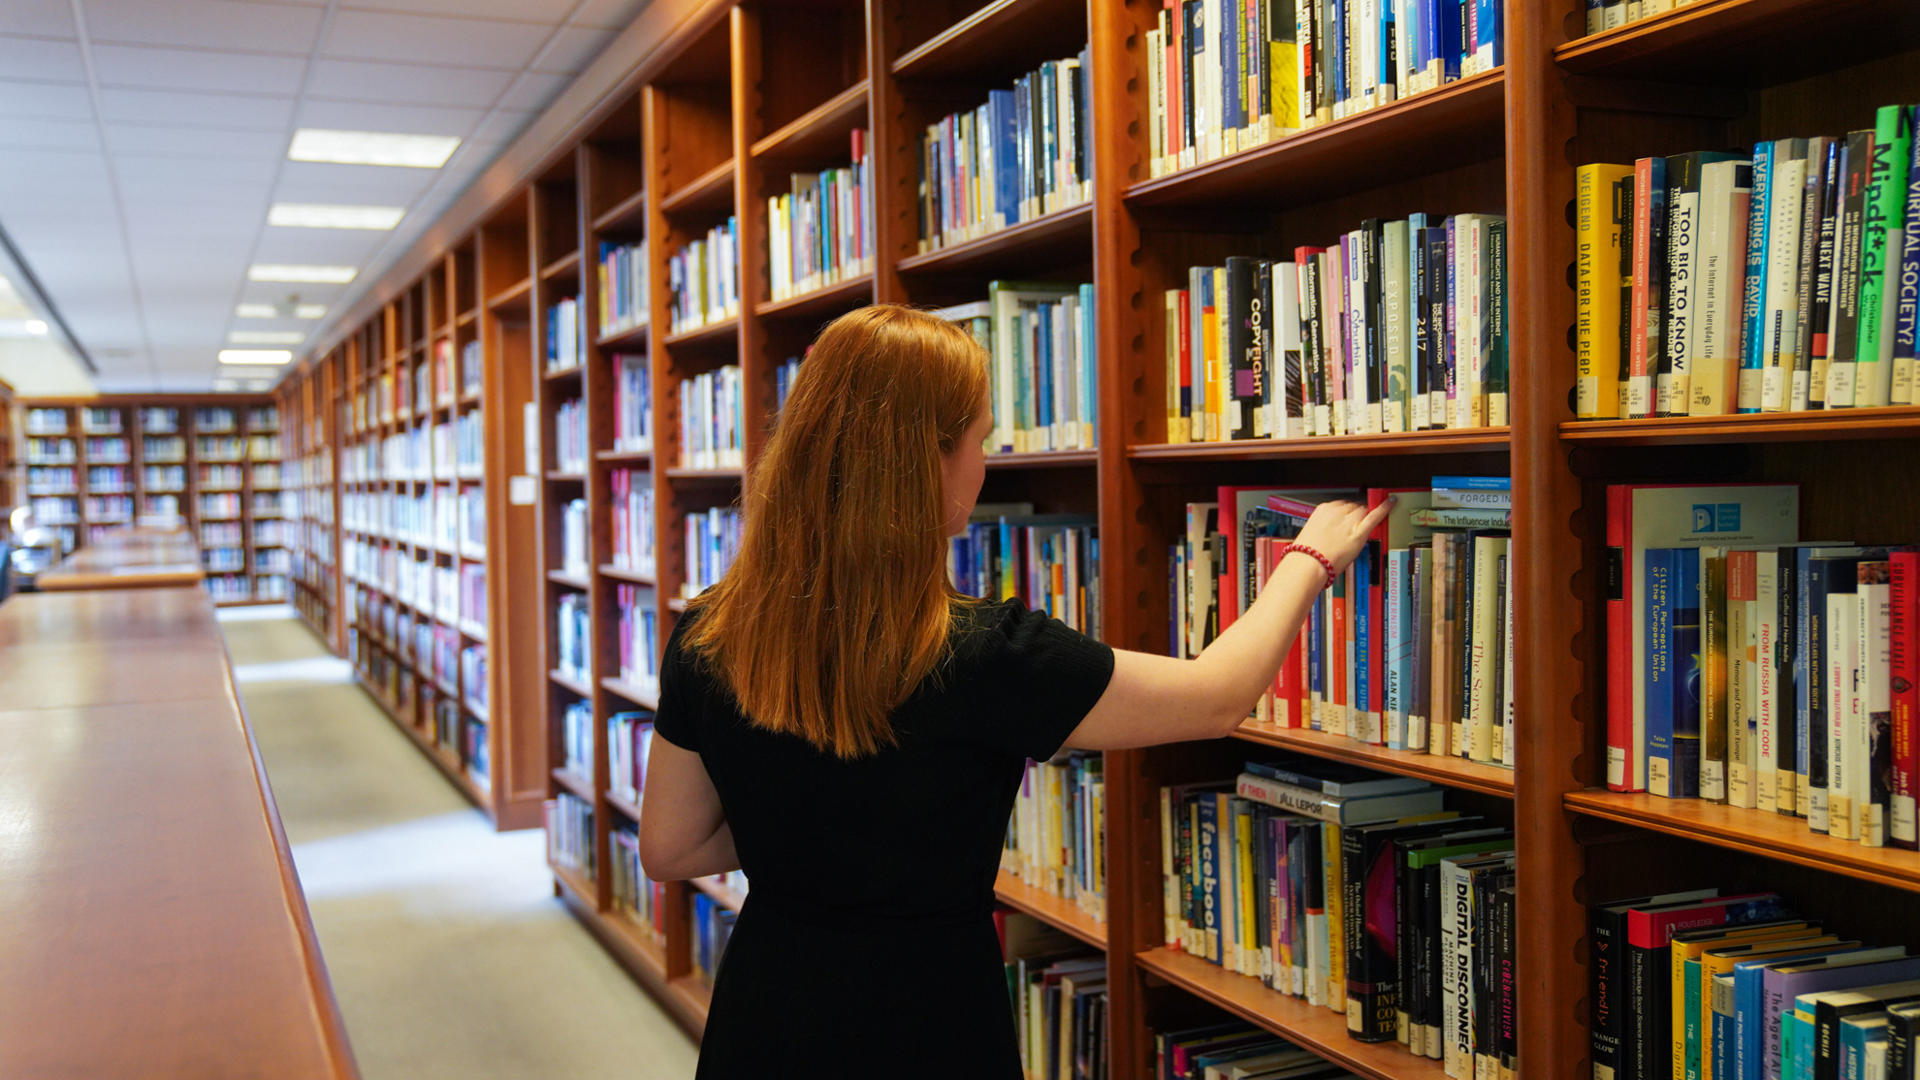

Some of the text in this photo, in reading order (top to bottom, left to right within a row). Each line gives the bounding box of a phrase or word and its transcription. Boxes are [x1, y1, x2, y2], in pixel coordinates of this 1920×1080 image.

[1580, 172, 1591, 232] WEIGEND
[1749, 152, 1768, 318] EVERYTHING IS DAVID
[1842, 225, 1852, 268] DEVELOPING
[1849, 224, 1860, 272] INFORMATION
[1580, 243, 1591, 276] DATA
[1666, 186, 1681, 357] THE INFORMATION SOCIETY READER
[1799, 193, 1815, 325] UNDERSTANDING THE INTERNET
[1817, 215, 1834, 303] THE NEXT WAVE
[1898, 179, 1920, 345] VIRTUAL SOCIETY?
[1307, 262, 1318, 319] Information
[1673, 208, 1691, 370] TOO BIG TO KNOW
[1704, 255, 1718, 359] The Internet in Everyday Life
[1840, 269, 1849, 309] COUNTRIES
[1847, 273, 1857, 318] REVOLUTION
[1351, 309, 1364, 367] Cyburbia
[1387, 280, 1400, 355] EXPOSED
[1580, 310, 1591, 335] THE
[1866, 293, 1878, 343] Christopher
[1250, 298, 1262, 397] COPYFIGHT
[1310, 319, 1320, 374] Generation
[1460, 494, 1499, 503] FORGED
[1443, 515, 1490, 526] The Influencer
[1359, 615, 1367, 634] HOW
[1390, 559, 1399, 694] DIGIMODERNISM ALAN
[1464, 600, 1473, 643] Computers,
[1651, 566, 1660, 682] of the European Union
[1658, 566, 1668, 673] Citizen Perceptions
[1892, 562, 1905, 671] SURVEILLANCE STATE
[1359, 637, 1367, 648] TO
[1463, 644, 1471, 673] Phones,
[1472, 640, 1485, 674] The
[1359, 666, 1367, 681] THE
[1733, 658, 1742, 689] Memory
[1761, 623, 1770, 759] FROM RUSSIA WITH CODE
[1359, 684, 1367, 712] FUTUR
[1470, 676, 1484, 727] Serve
[1733, 702, 1742, 727] Change
[1733, 737, 1742, 762] Europe
[1735, 728, 1742, 736] in
[1296, 797, 1322, 814] LEPOR
[1595, 927, 1611, 937] THE
[1457, 882, 1469, 1054] DIGITAL DISCONNEC
[1636, 952, 1644, 964] The
[1636, 964, 1644, 995] Routledge
[1597, 957, 1610, 1028] friendly
[1636, 995, 1644, 1014] Social
[1636, 1014, 1644, 1039] Science
[1717, 1015, 1725, 1040] Emerging
[1769, 992, 1783, 1074] The Age of AI
[1717, 1040, 1725, 1058] Digital
[1737, 1051, 1744, 1059] OF
